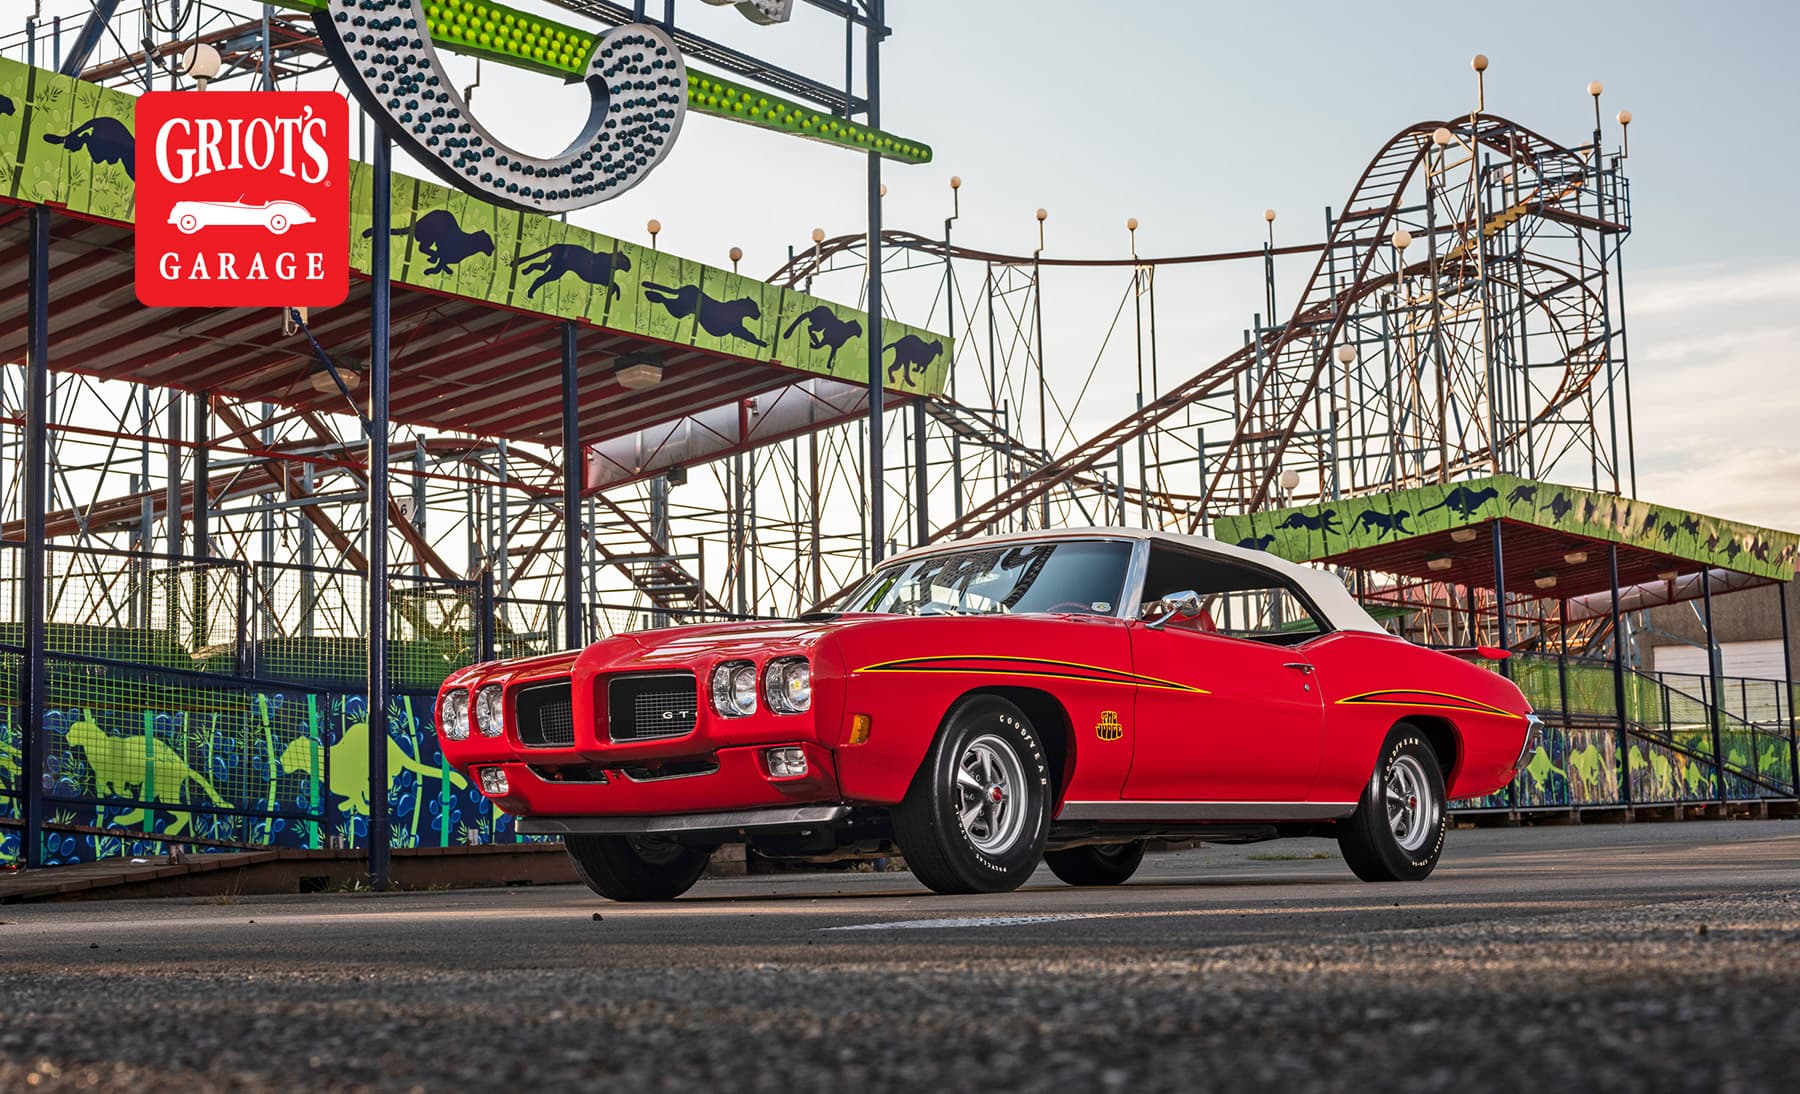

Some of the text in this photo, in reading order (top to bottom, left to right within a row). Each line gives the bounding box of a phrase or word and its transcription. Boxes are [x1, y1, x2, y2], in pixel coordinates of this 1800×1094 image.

[662, 711, 698, 719] GT
[1101, 711, 1117, 724] THE
[1095, 724, 1123, 740] JUDGE
[1000, 714, 1047, 785] GOODYEAR
[1384, 738, 1418, 781] GOODYEAR
